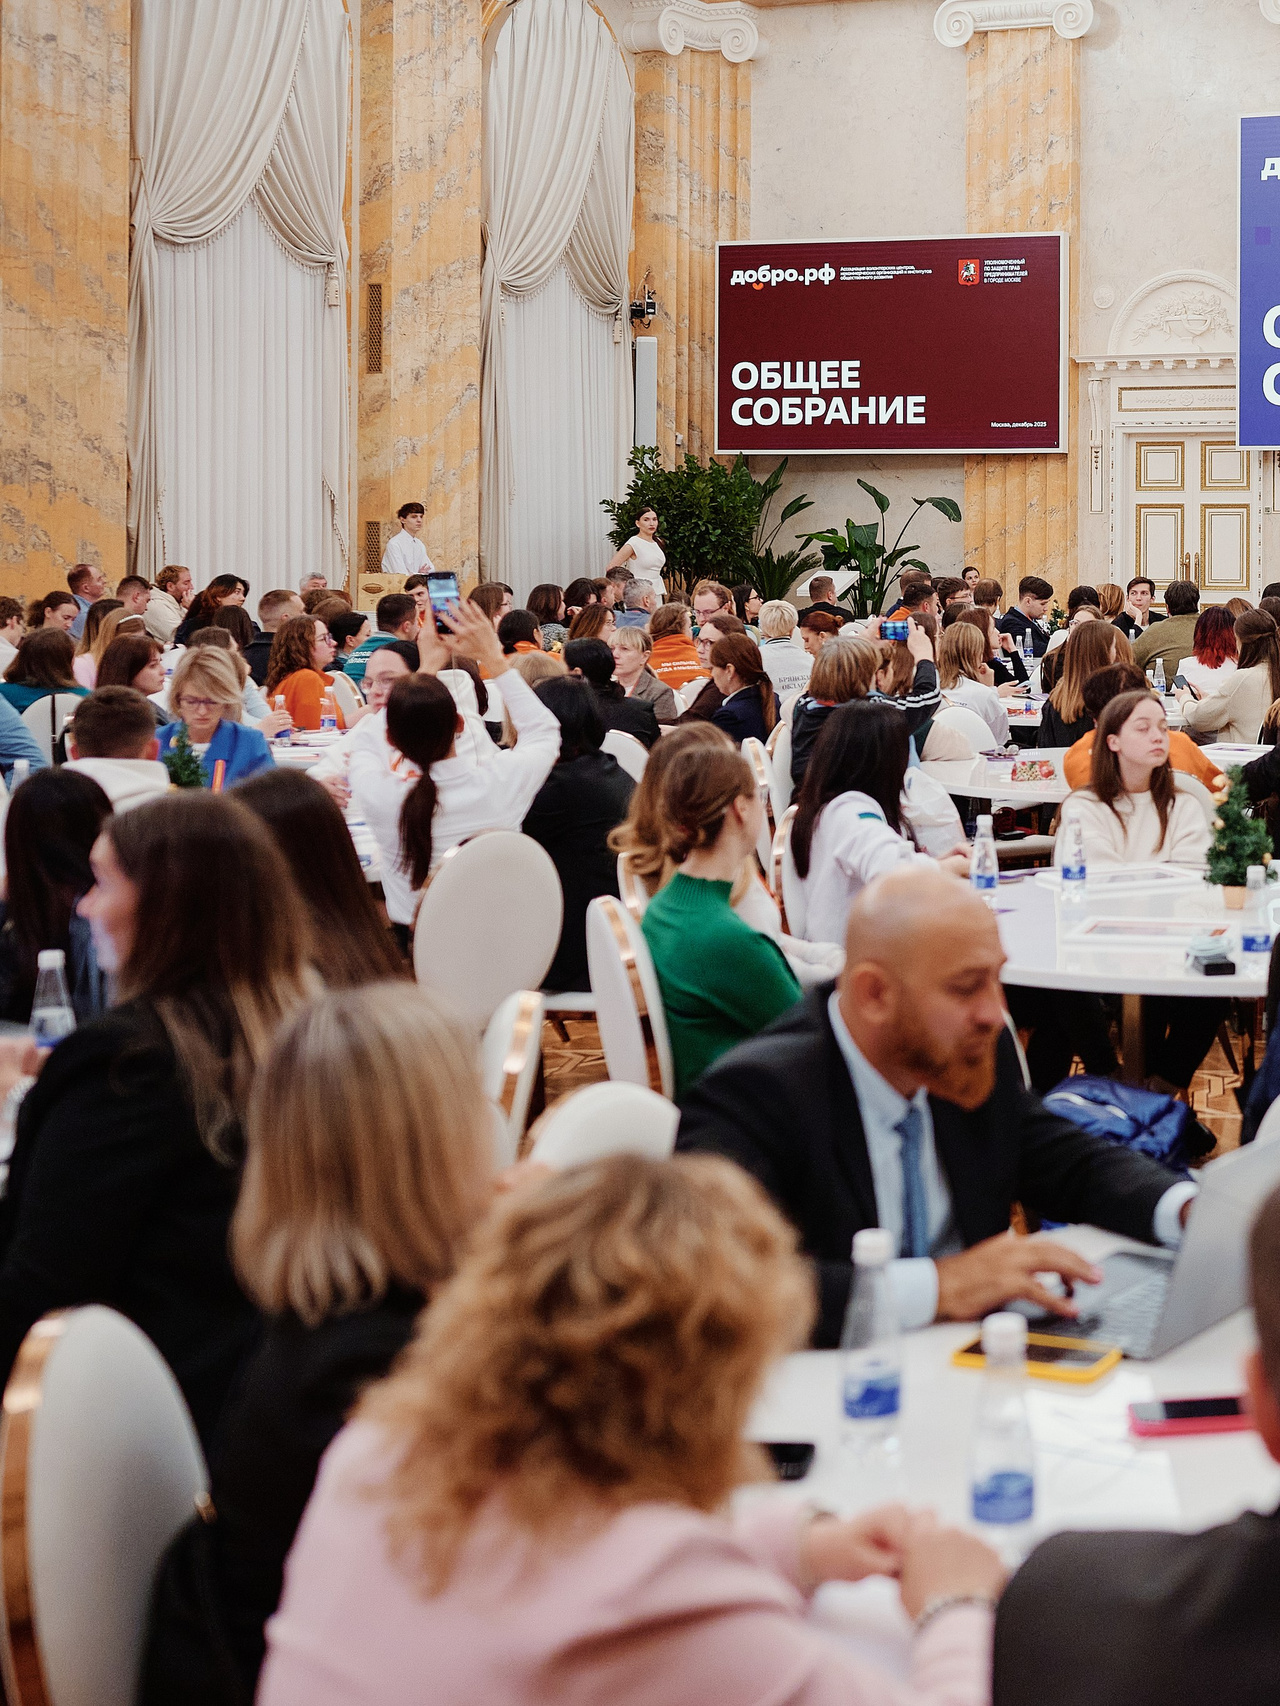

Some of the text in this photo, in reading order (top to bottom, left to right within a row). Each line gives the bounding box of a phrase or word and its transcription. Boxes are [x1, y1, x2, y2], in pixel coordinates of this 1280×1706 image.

[730, 262, 836, 286] добро.рф
[731, 360, 861, 395] ОБЩЕЕ
[731, 395, 926, 426] СОБРАНИЕ
[778, 674, 812, 683] БРЯНСКА
